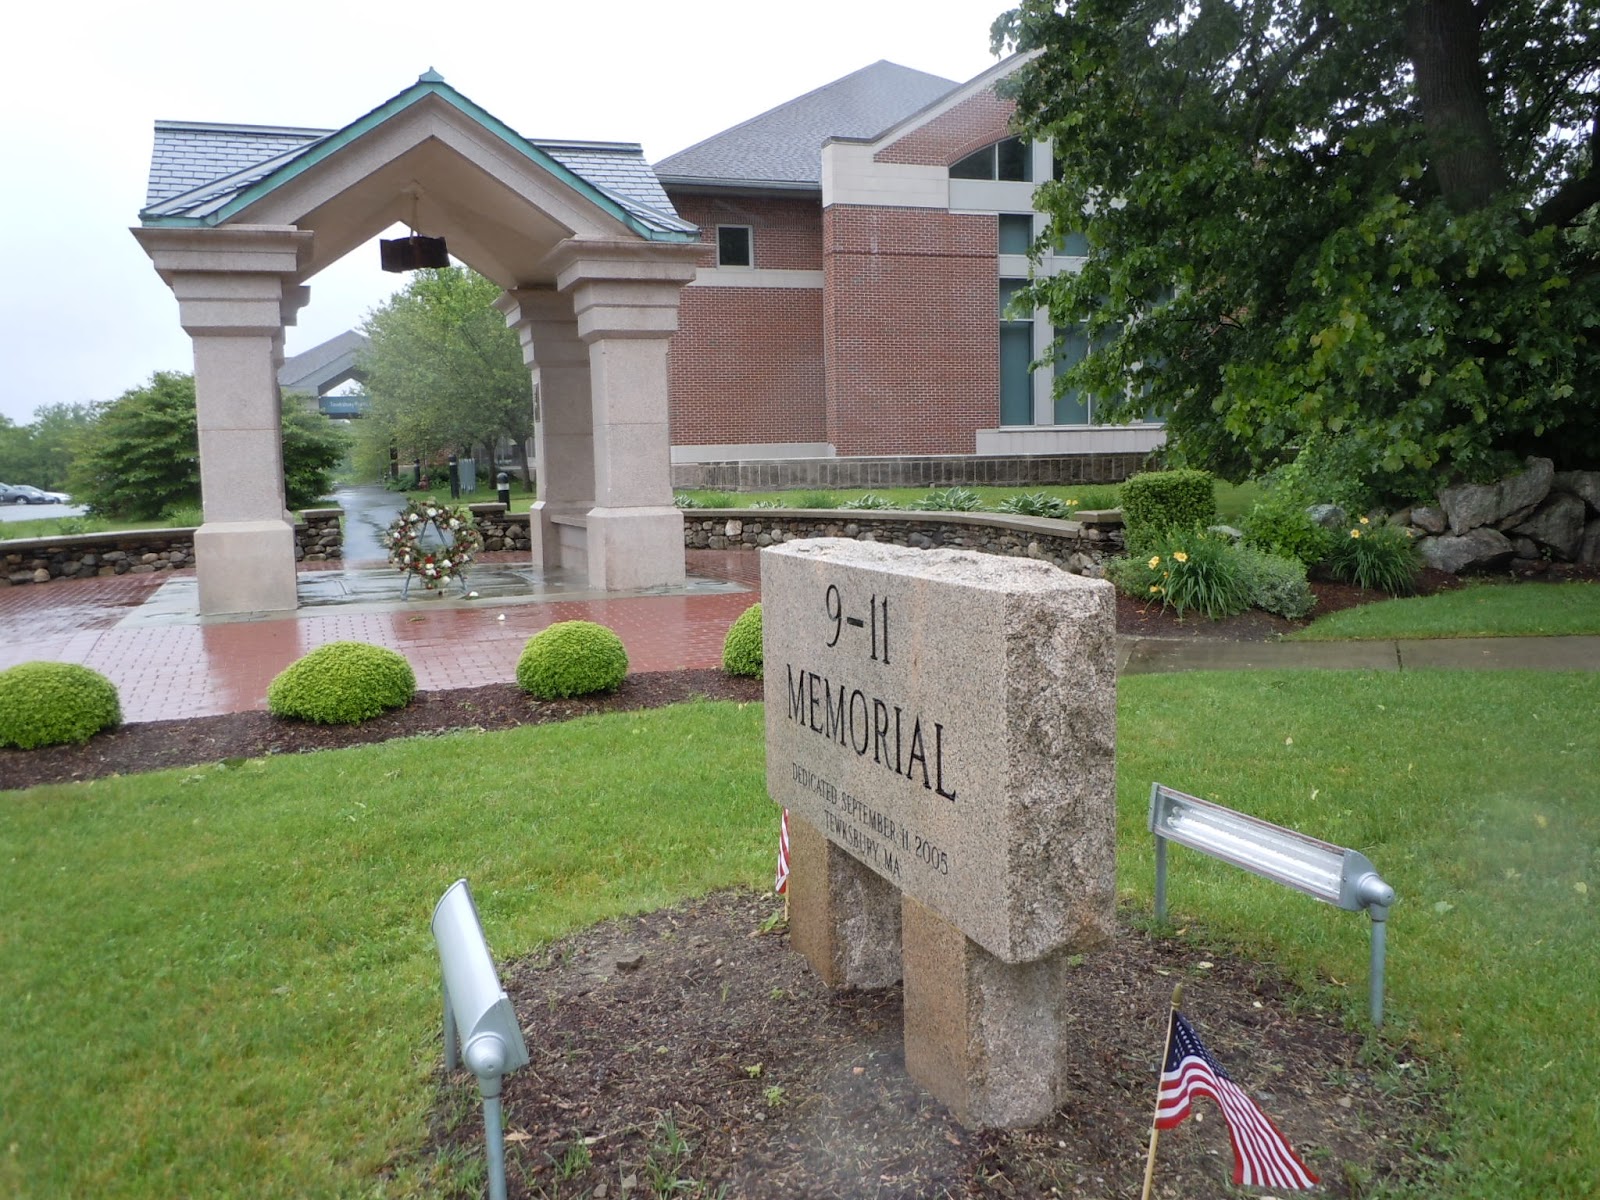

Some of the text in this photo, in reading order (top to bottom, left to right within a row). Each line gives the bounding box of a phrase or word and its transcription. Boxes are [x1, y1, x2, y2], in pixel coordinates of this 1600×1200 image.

[825, 584, 891, 664] 9-11
[787, 663, 956, 802] MEMORIAL
[792, 762, 837, 805] DEDICATED
[841, 792, 896, 842] SEPTEMBER
[915, 836, 948, 875] 2005
[884, 848, 901, 877] MA
